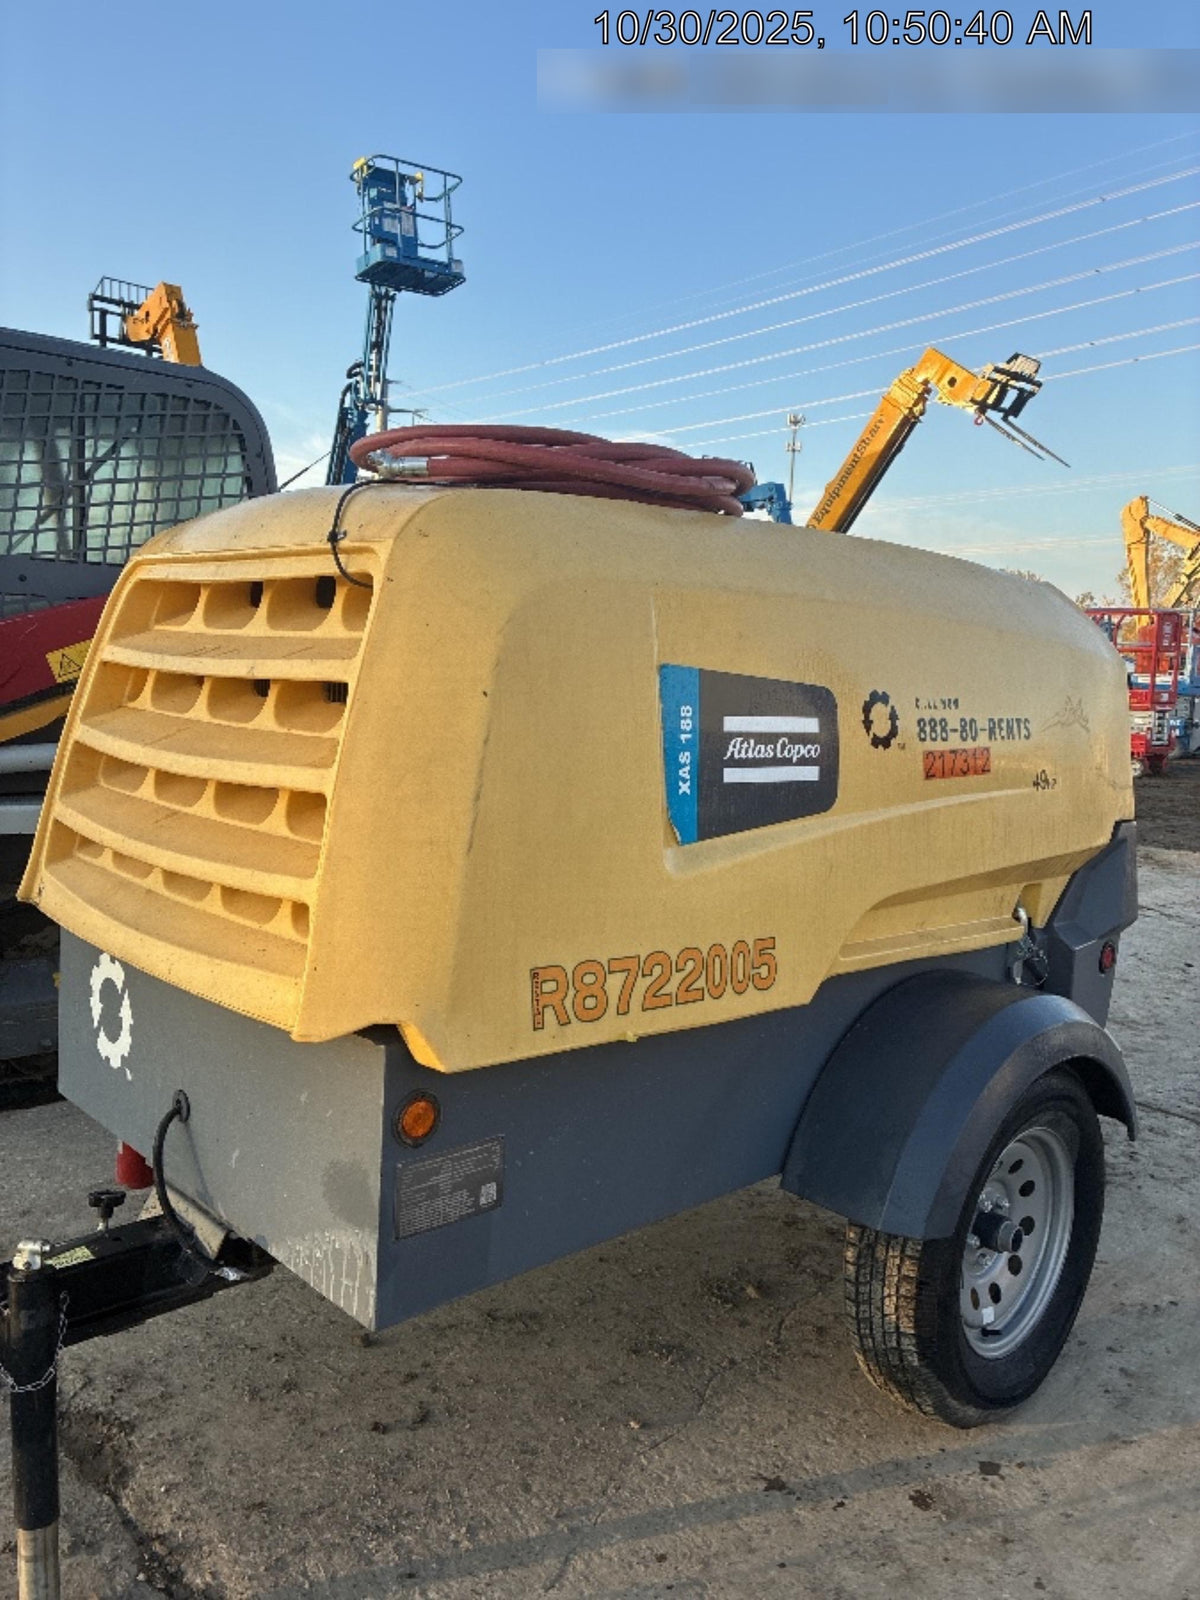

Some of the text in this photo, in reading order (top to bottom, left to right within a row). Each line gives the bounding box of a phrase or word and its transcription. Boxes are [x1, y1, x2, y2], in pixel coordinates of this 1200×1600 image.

[916, 717, 1031, 742] 888-80-RENTS
[678, 705, 693, 796] XAS 188
[723, 737, 821, 764] Atlas Copco
[924, 747, 991, 780] 217312
[530, 937, 777, 1031] R8722005
